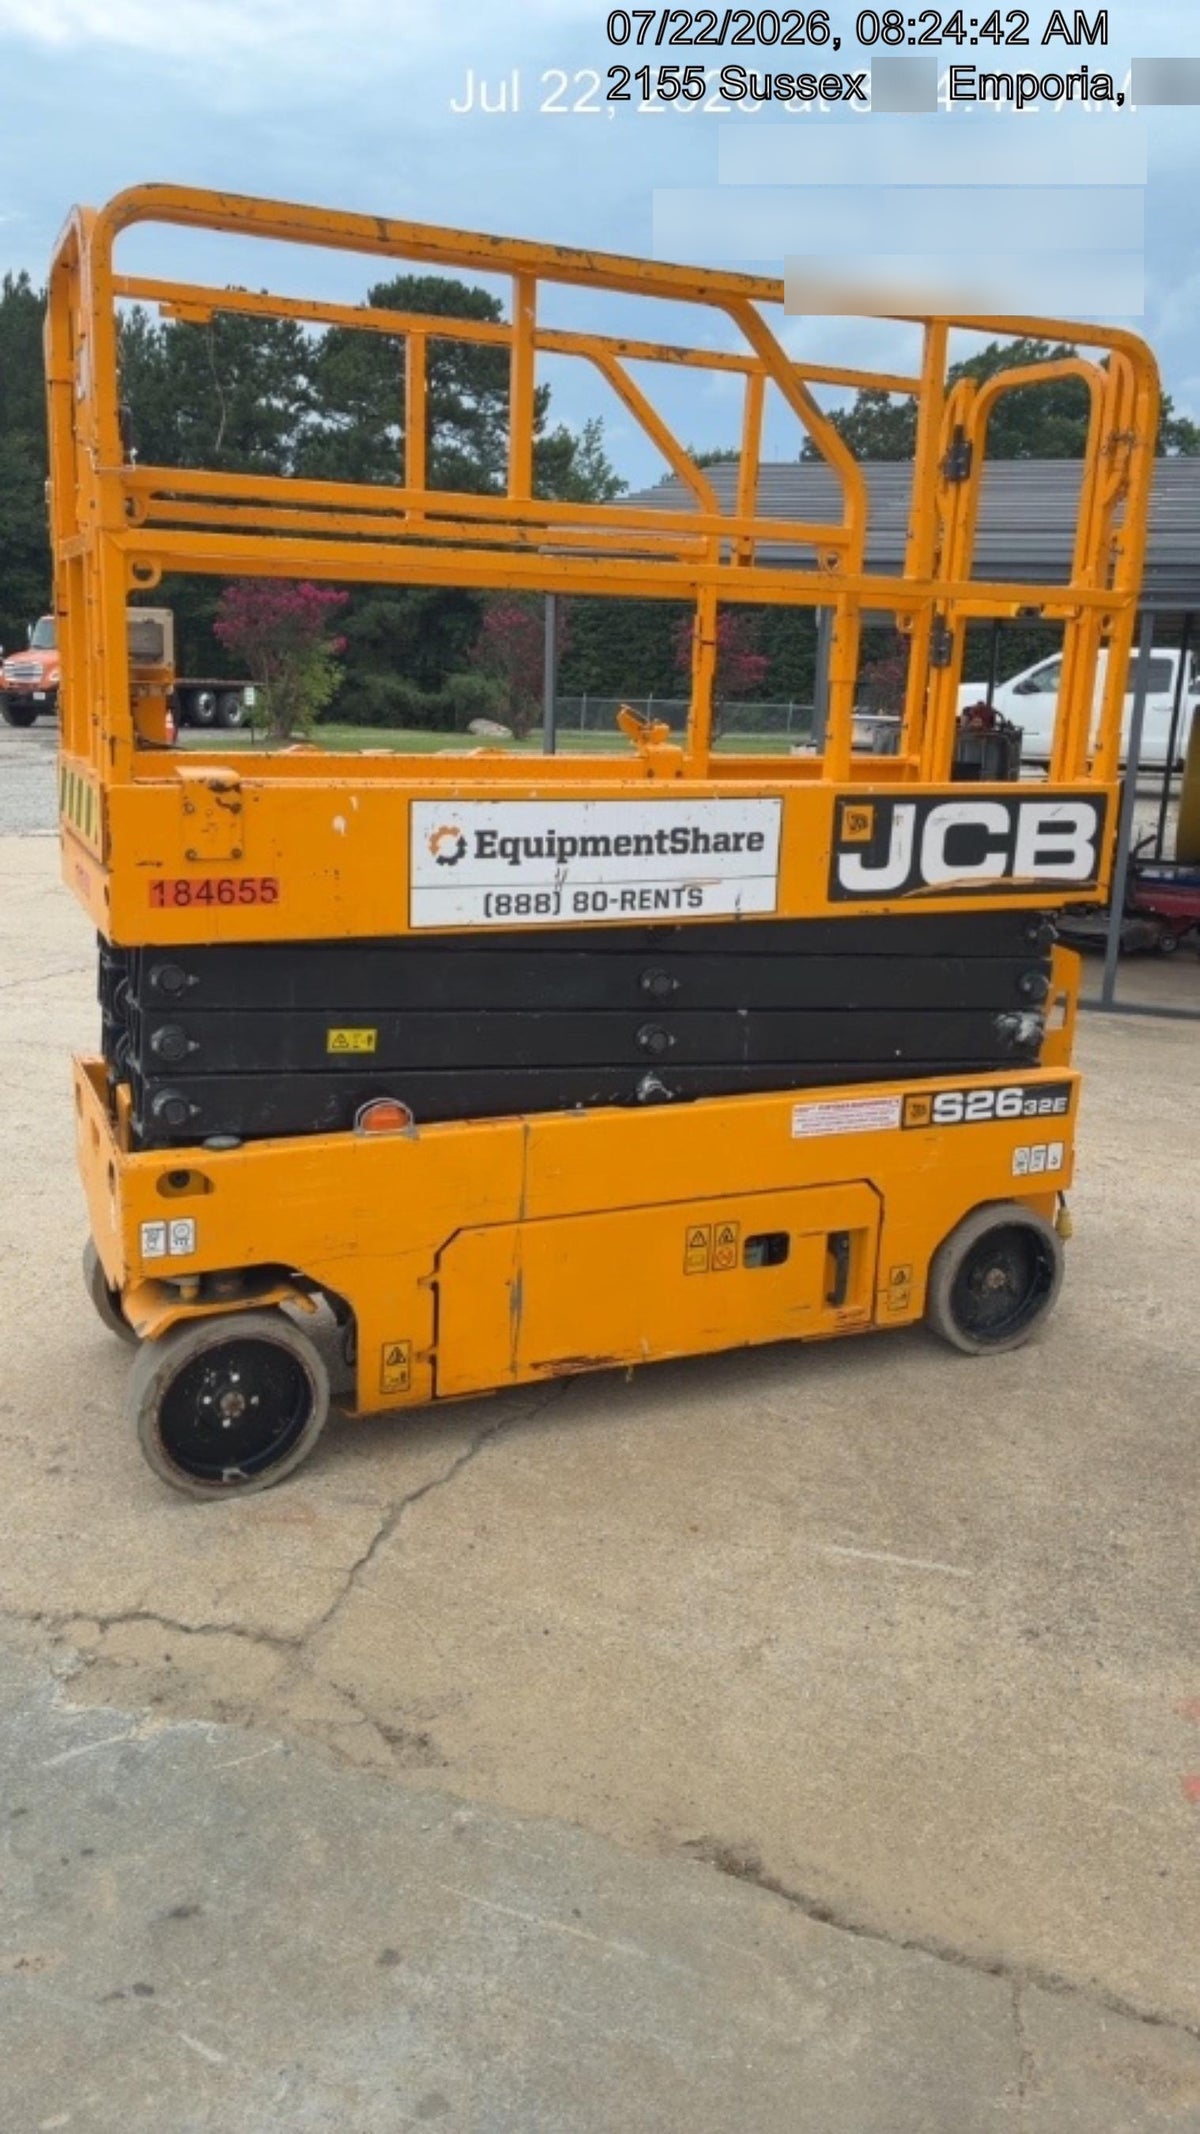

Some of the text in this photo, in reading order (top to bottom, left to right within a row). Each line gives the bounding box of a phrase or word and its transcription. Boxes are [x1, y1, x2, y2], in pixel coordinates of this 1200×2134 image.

[473, 827, 765, 866] EquipmentShare
[838, 801, 1097, 891] JCB
[151, 877, 279, 907] 184655
[483, 886, 704, 918] (888) 80-RENTS
